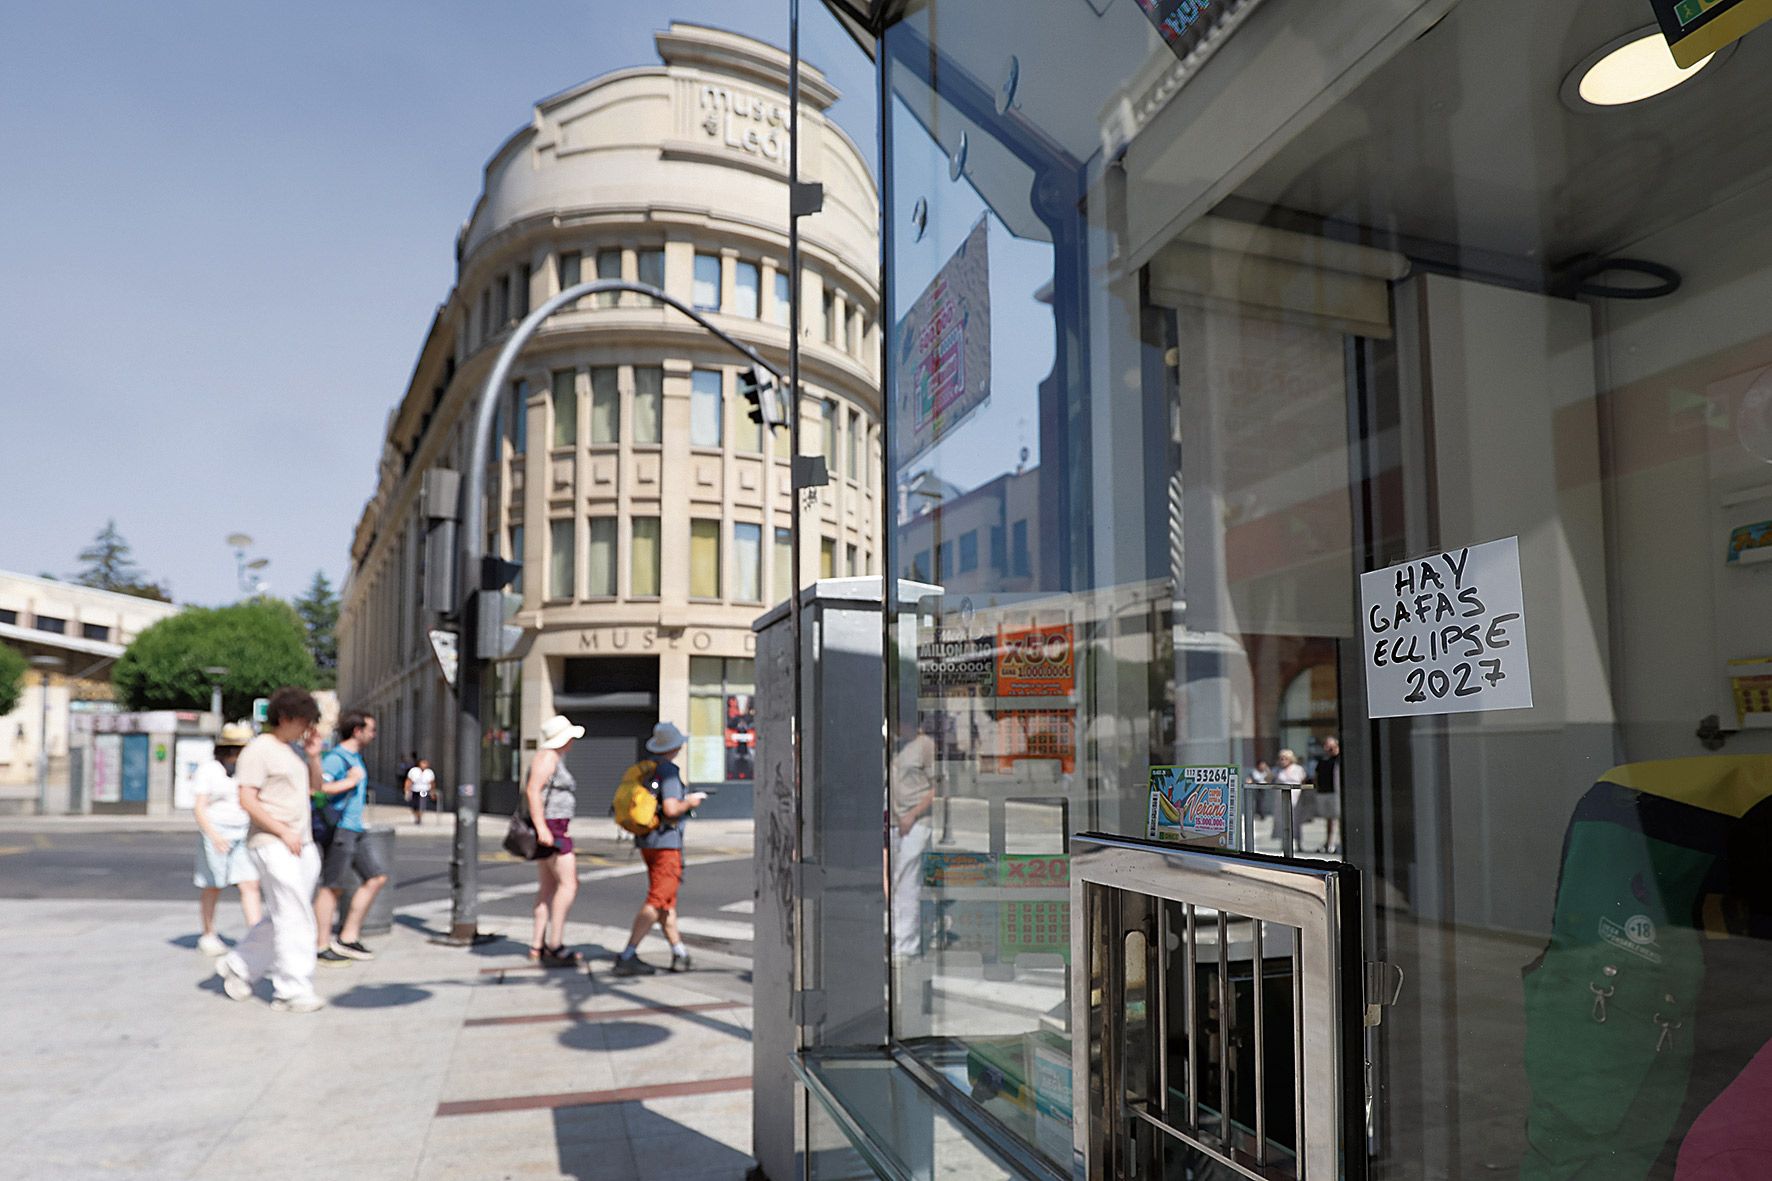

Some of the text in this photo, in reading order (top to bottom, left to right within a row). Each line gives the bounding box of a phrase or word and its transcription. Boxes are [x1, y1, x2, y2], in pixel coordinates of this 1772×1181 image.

[1394, 547, 1468, 596] HAY
[1369, 587, 1486, 633] GAFAS
[578, 631, 712, 650] MUSEO
[920, 643, 992, 657] MILLONARIO
[1373, 612, 1520, 667] ECLIPSE
[920, 662, 992, 672] 1.000.000€
[1404, 658, 1506, 703] 2027
[1196, 768, 1227, 783] 53264
[1184, 788, 1227, 821] Verano
